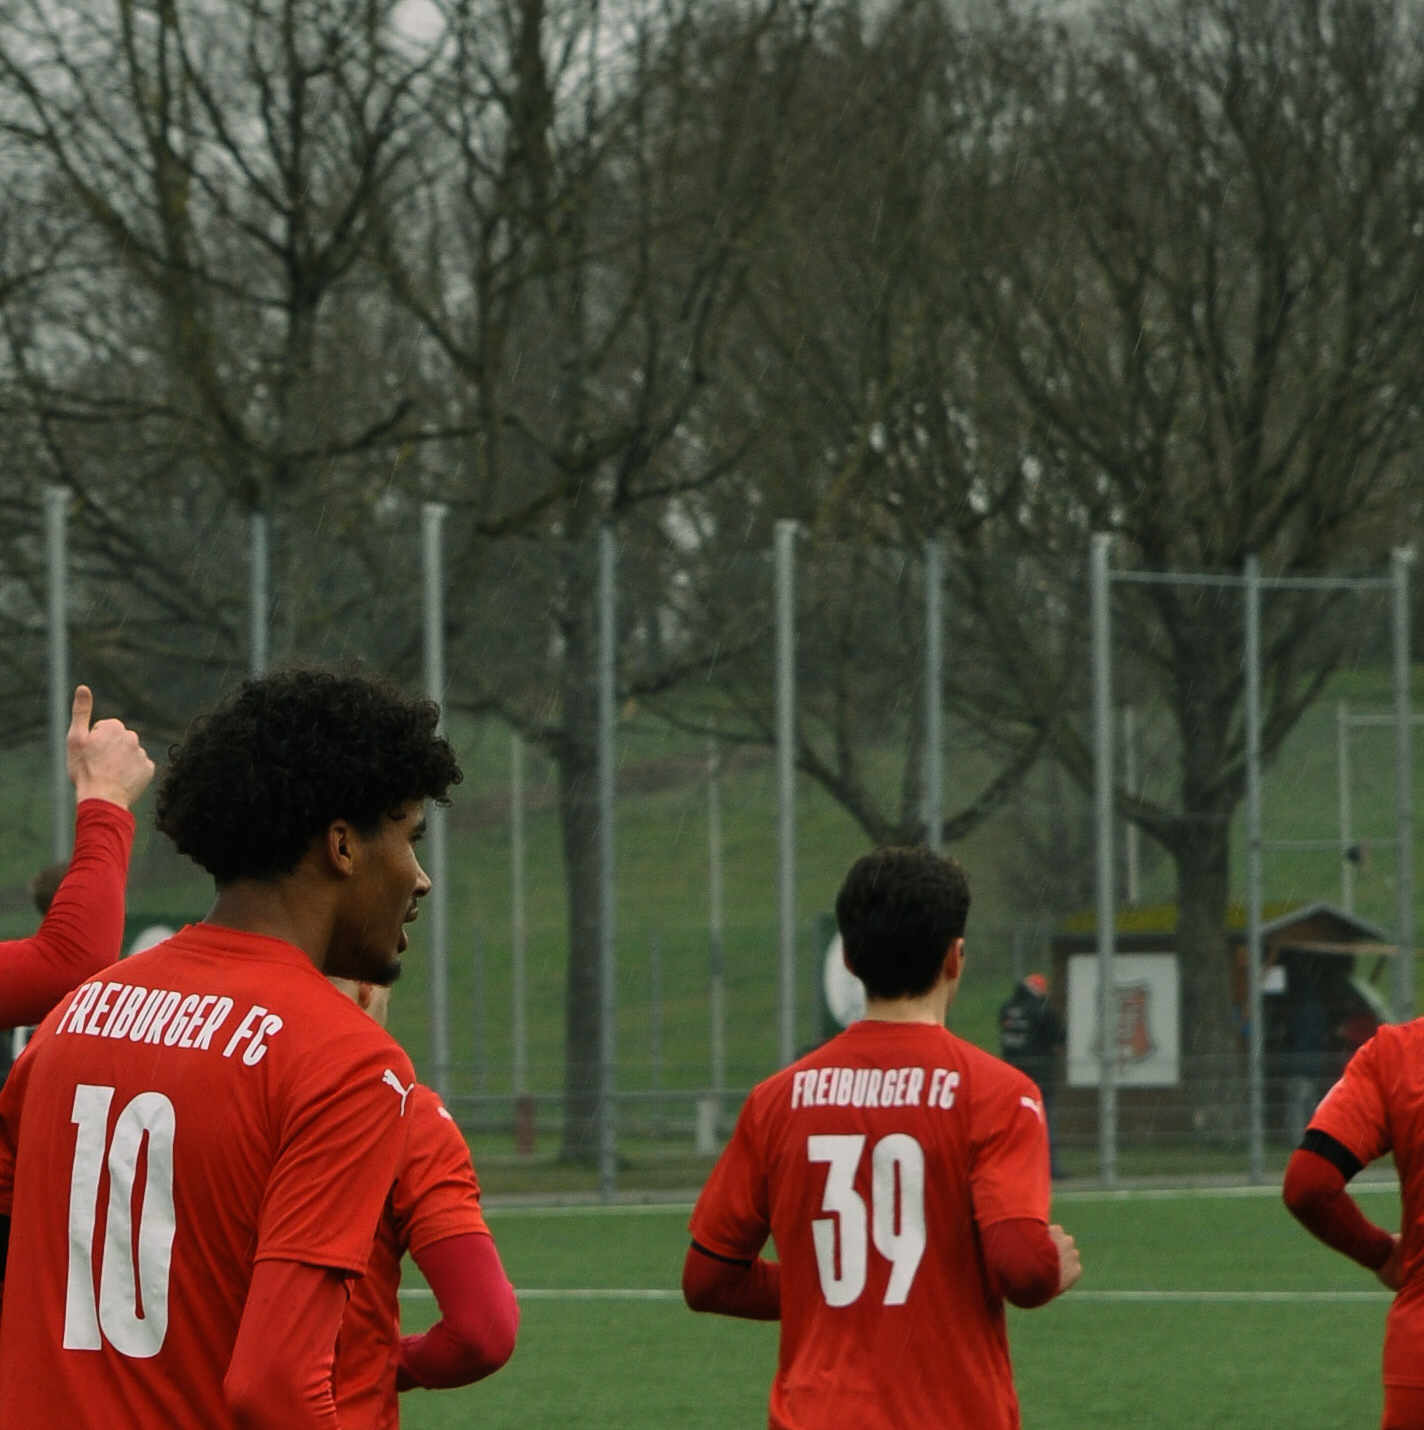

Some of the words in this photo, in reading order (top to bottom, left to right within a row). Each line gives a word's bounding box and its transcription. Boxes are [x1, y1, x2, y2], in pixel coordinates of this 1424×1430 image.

[55, 980, 234, 1051] FREIBURGER
[222, 1004, 284, 1067] FC
[791, 1067, 925, 1110] FREIBURGER
[927, 1068, 960, 1111] FC
[62, 1083, 177, 1359] 10
[807, 1133, 927, 1308] 39
